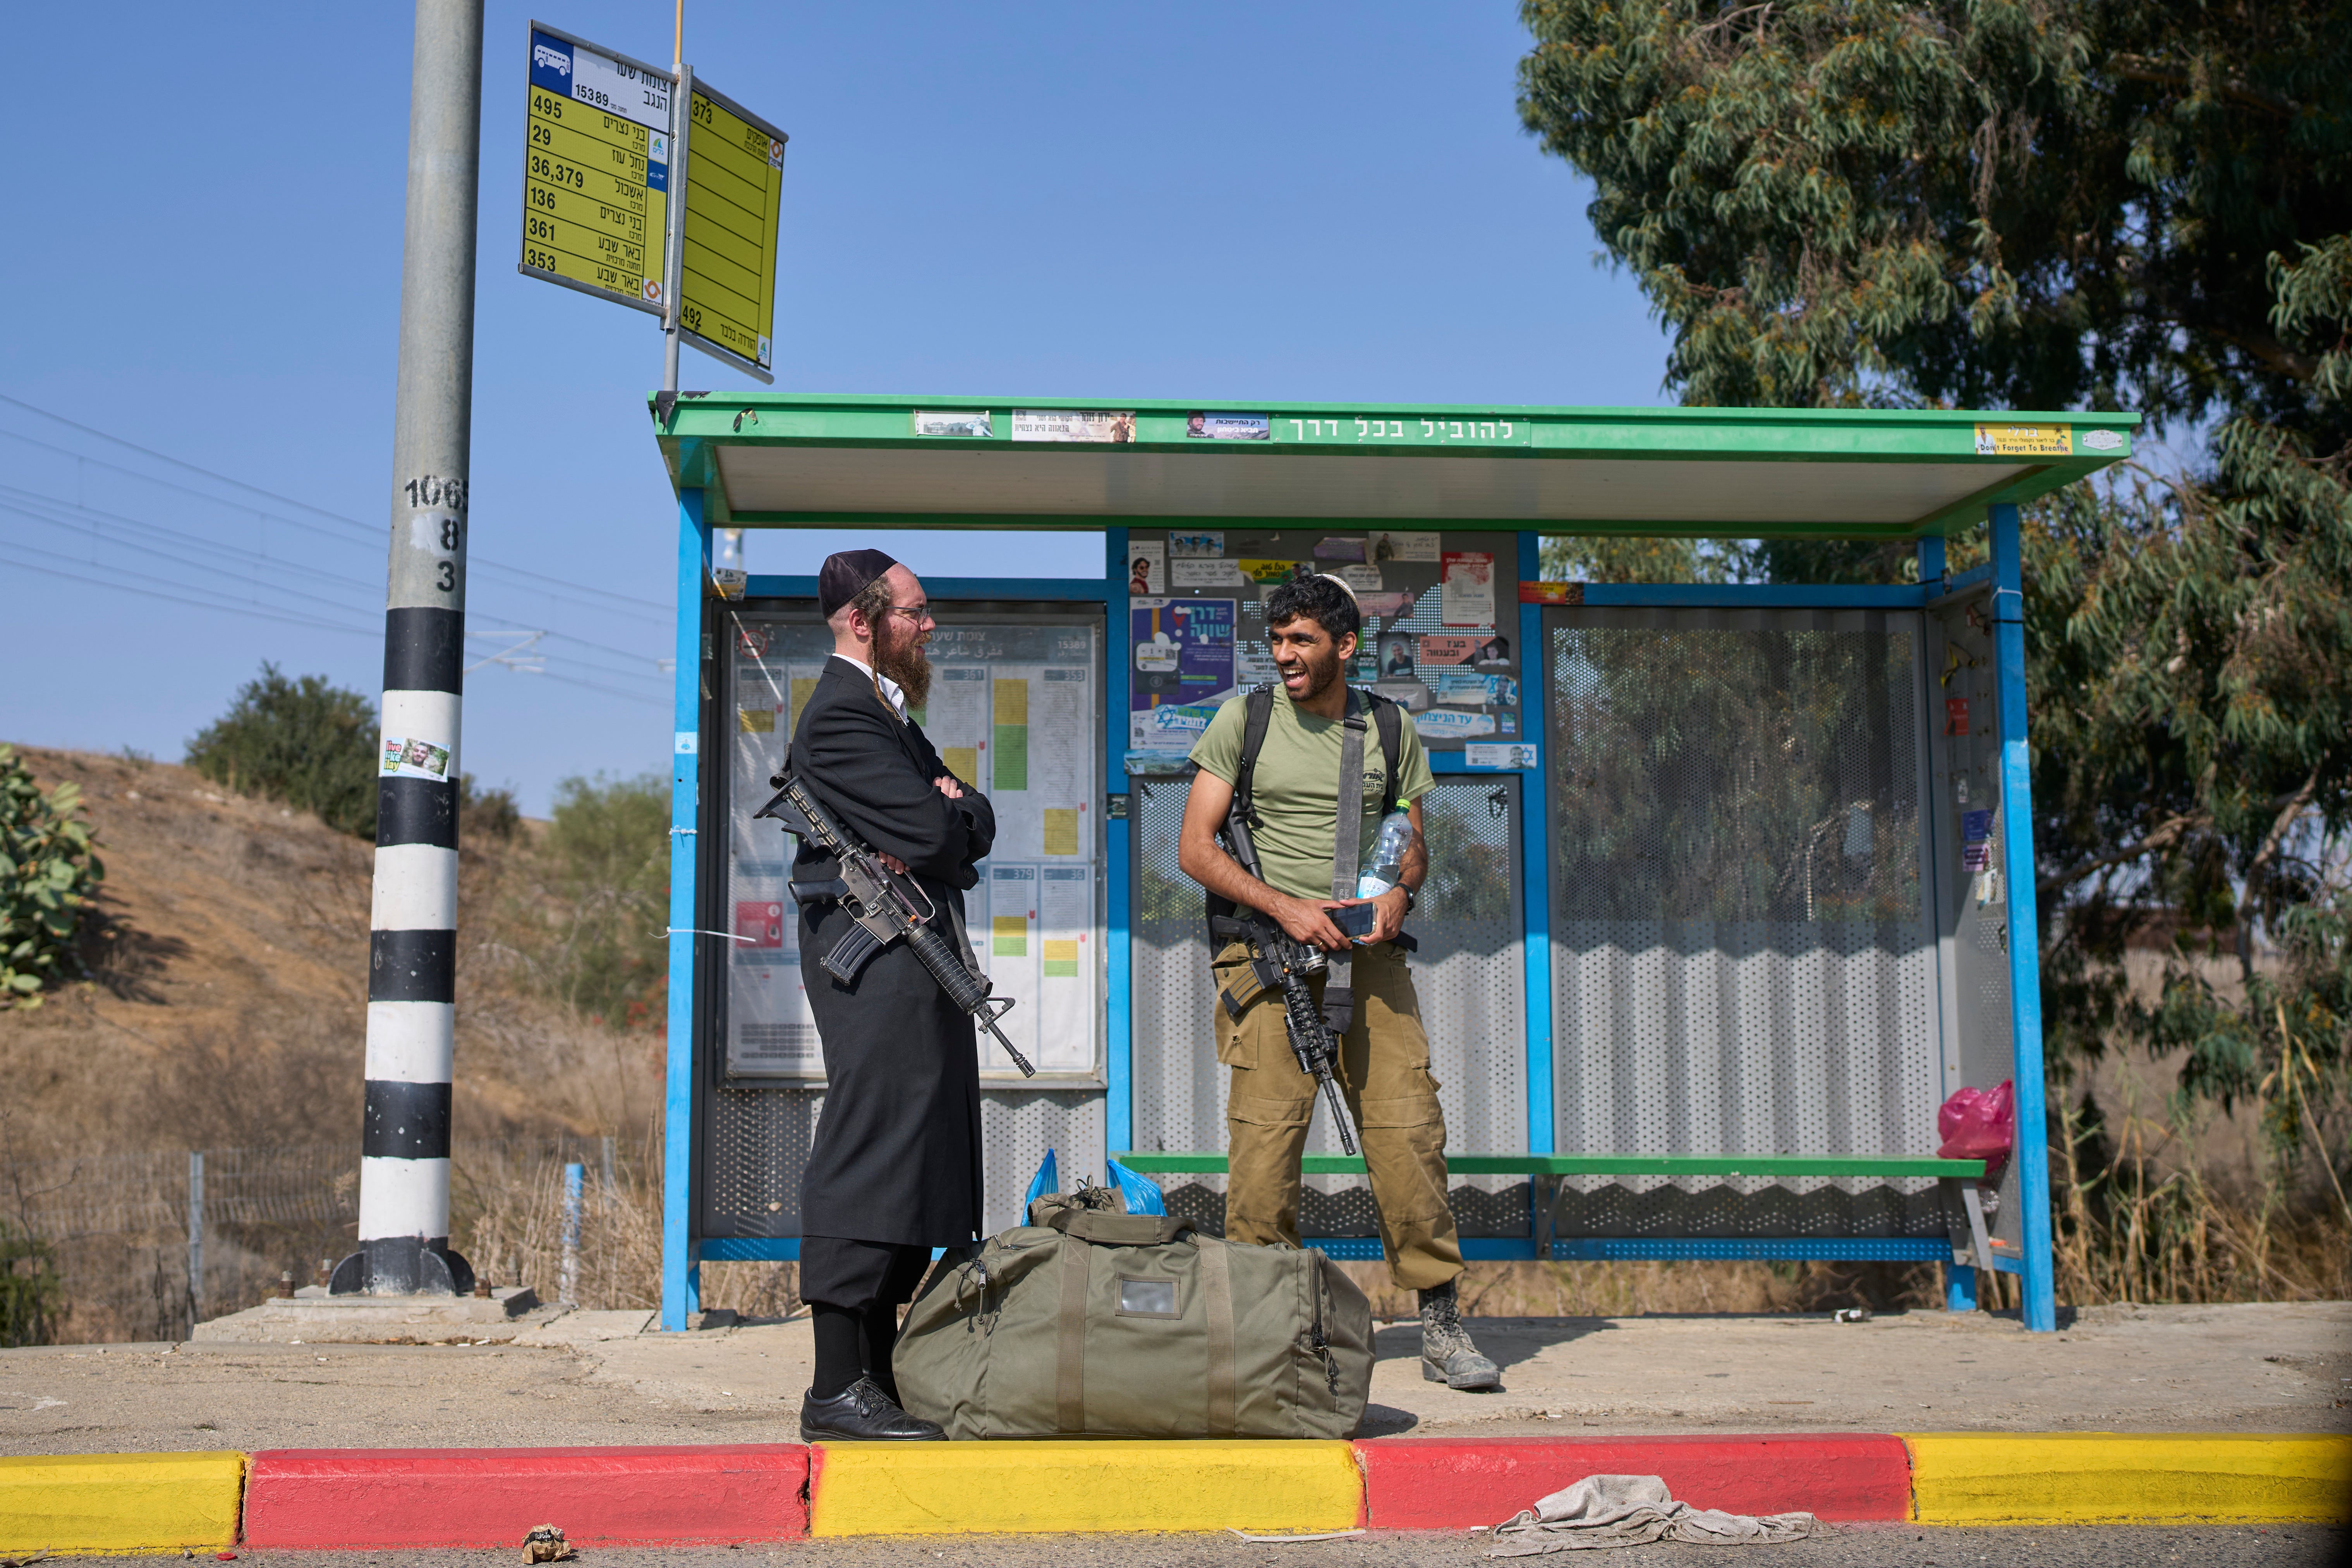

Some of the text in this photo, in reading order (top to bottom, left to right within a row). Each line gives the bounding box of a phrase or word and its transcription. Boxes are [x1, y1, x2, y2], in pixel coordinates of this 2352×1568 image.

[576, 84, 608, 106] 15389
[643, 91, 667, 112] הנגב
[534, 95, 562, 119] 495
[693, 100, 712, 124] 373
[533, 125, 551, 145] 29
[604, 116, 645, 141] בני נצרים
[747, 128, 768, 149] אופקים
[632, 141, 645, 152] מרכז
[613, 149, 644, 171] נחל עוז
[532, 156, 583, 188] 36,379
[631, 171, 644, 182] מרכז
[531, 187, 555, 210] 136
[615, 179, 643, 201] אשכול
[630, 201, 643, 211] מרכז
[600, 206, 642, 231] בני נצרים
[529, 218, 555, 241] 361
[629, 231, 642, 241] מרכז
[598, 237, 640, 261] באר שבע
[528, 249, 555, 272] 353
[627, 261, 640, 271] תחנה
[597, 267, 639, 291] באר שבע
[683, 305, 701, 327] 492
[721, 324, 755, 351] הורדה בלבד
[1290, 418, 1512, 440] להוביל בכל דרך
[440, 519, 459, 551] 8
[437, 560, 455, 592] 3
[956, 632, 985, 641] צומת
[1057, 641, 1087, 649] 15389
[964, 670, 982, 680] 361
[1065, 670, 1083, 680] 353
[1458, 714, 1472, 725] עד
[385, 751, 401, 762] like
[386, 740, 401, 752] live
[384, 759, 400, 773] ilay
[1013, 869, 1032, 879] 379
[1071, 869, 1083, 879] 36
